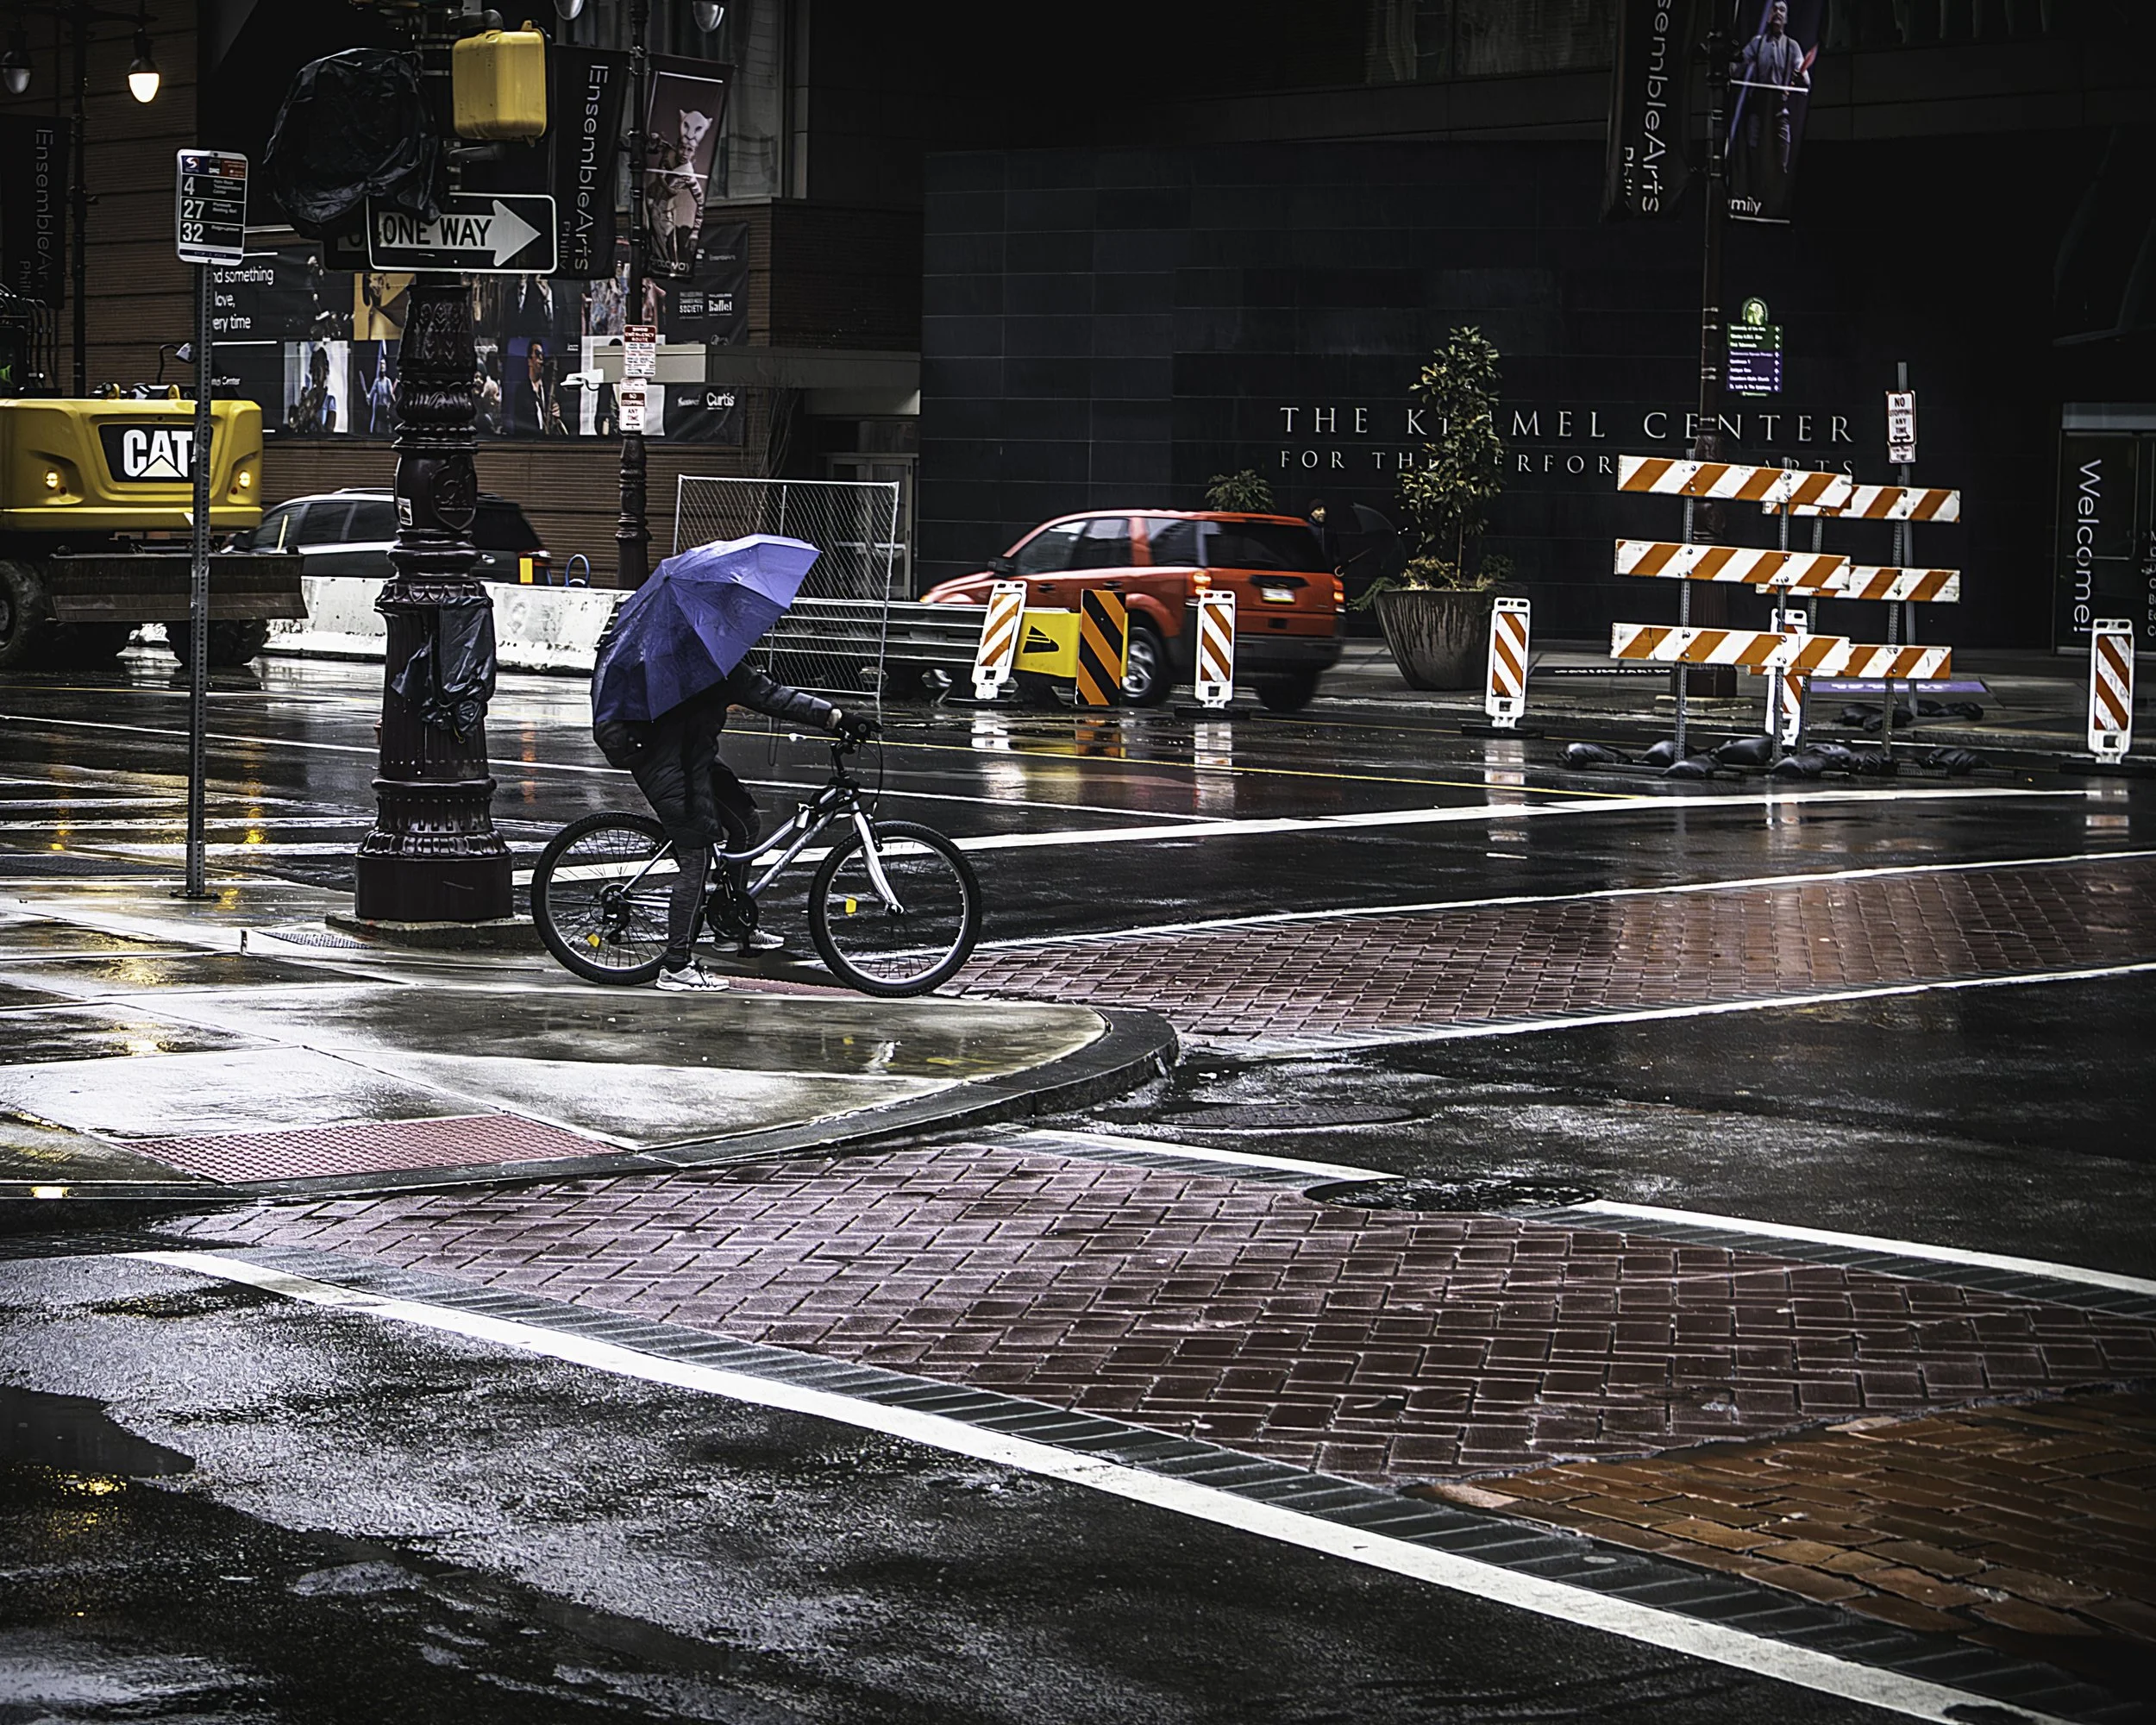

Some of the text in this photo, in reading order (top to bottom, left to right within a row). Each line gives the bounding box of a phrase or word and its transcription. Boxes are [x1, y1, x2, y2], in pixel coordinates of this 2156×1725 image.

[574, 65, 610, 270] EnsembleArts
[183, 176, 195, 195] 4
[182, 199, 205, 219] 27
[181, 223, 204, 242] 32
[383, 216, 431, 246] ONE
[440, 217, 493, 248] WAY
[224, 266, 274, 285] something
[215, 291, 235, 308] love,
[229, 313, 252, 329] time
[706, 392, 735, 407] Curtis
[1895, 397, 1906, 408] NO
[1280, 407, 1854, 442] THE KIMEL CENTER
[123, 429, 193, 478] CAT
[1280, 450, 1344, 471] FOR
[2072, 458, 2103, 634] Welcome!
